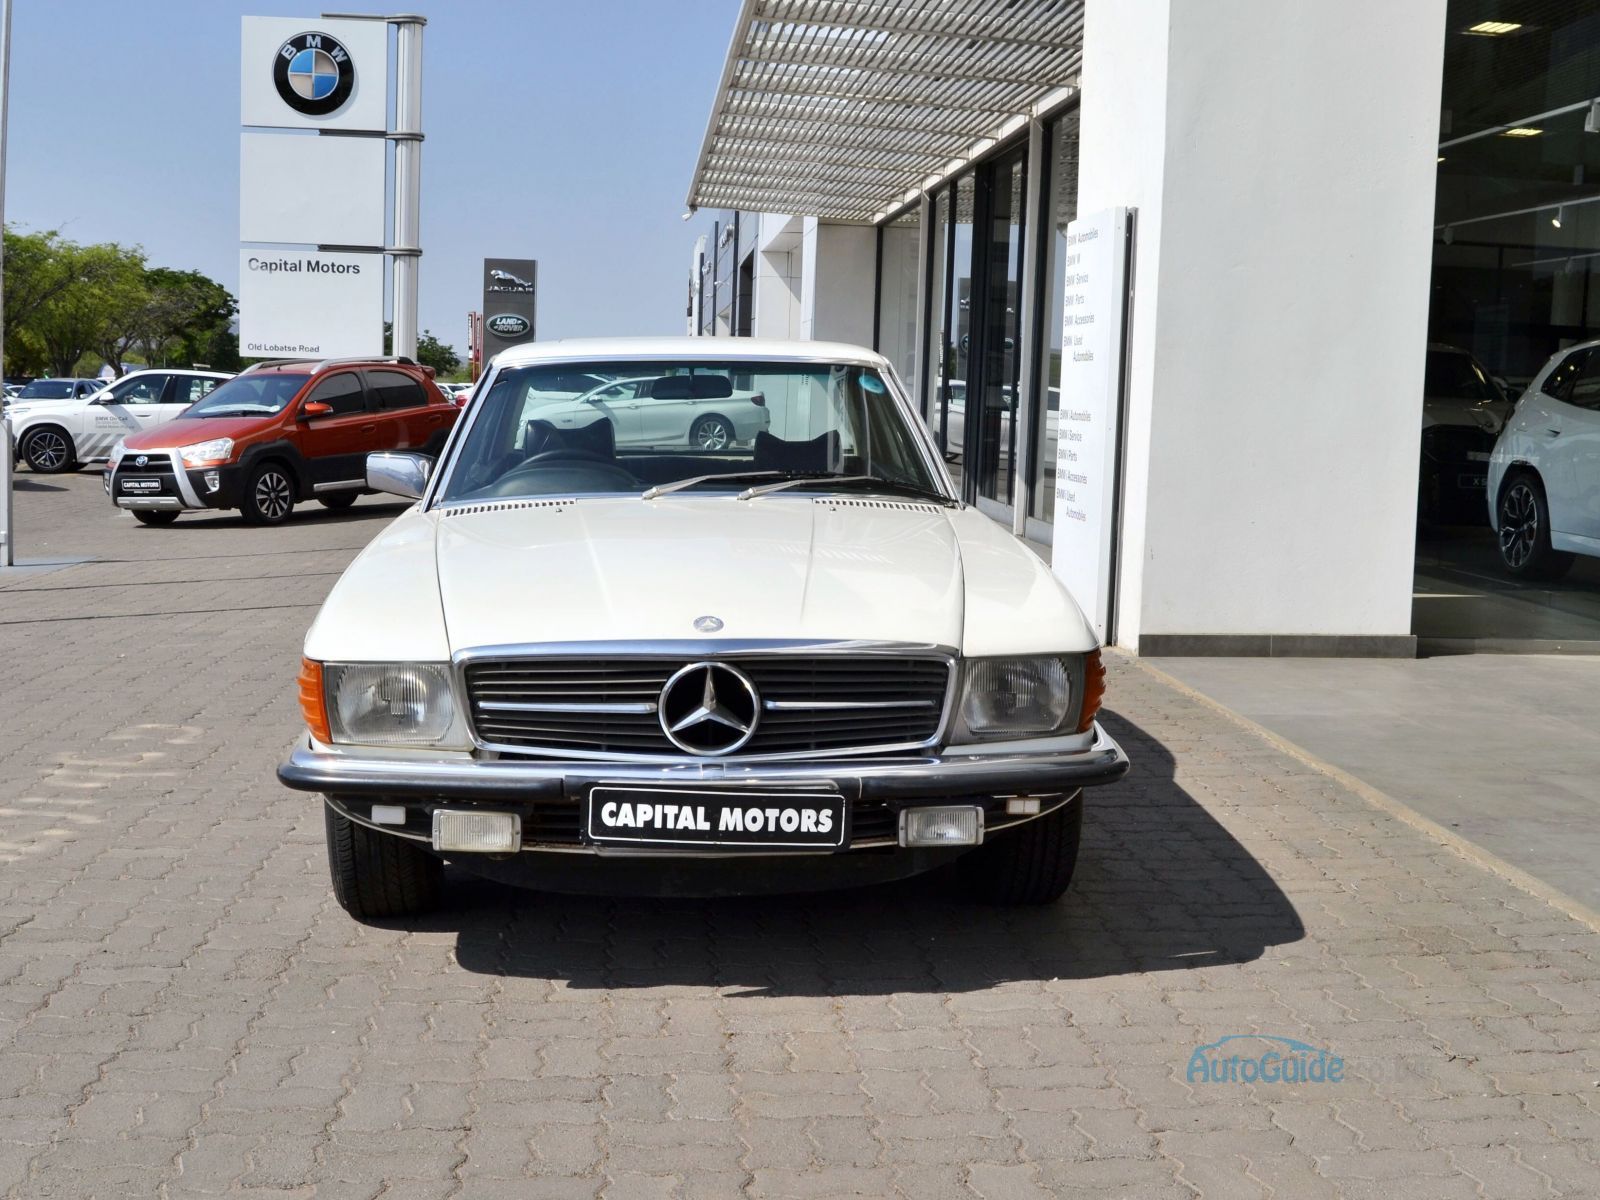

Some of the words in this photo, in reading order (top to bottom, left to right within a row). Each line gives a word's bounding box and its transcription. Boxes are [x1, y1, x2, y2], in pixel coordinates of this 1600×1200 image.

[281, 35, 348, 63] BMW
[248, 258, 302, 274] Capital
[307, 260, 360, 274] Motors
[248, 343, 262, 351] Old
[264, 344, 297, 352] Lobatse
[299, 345, 320, 353] Road
[601, 802, 710, 831] CAPITAL
[719, 807, 833, 833] MOTORS
